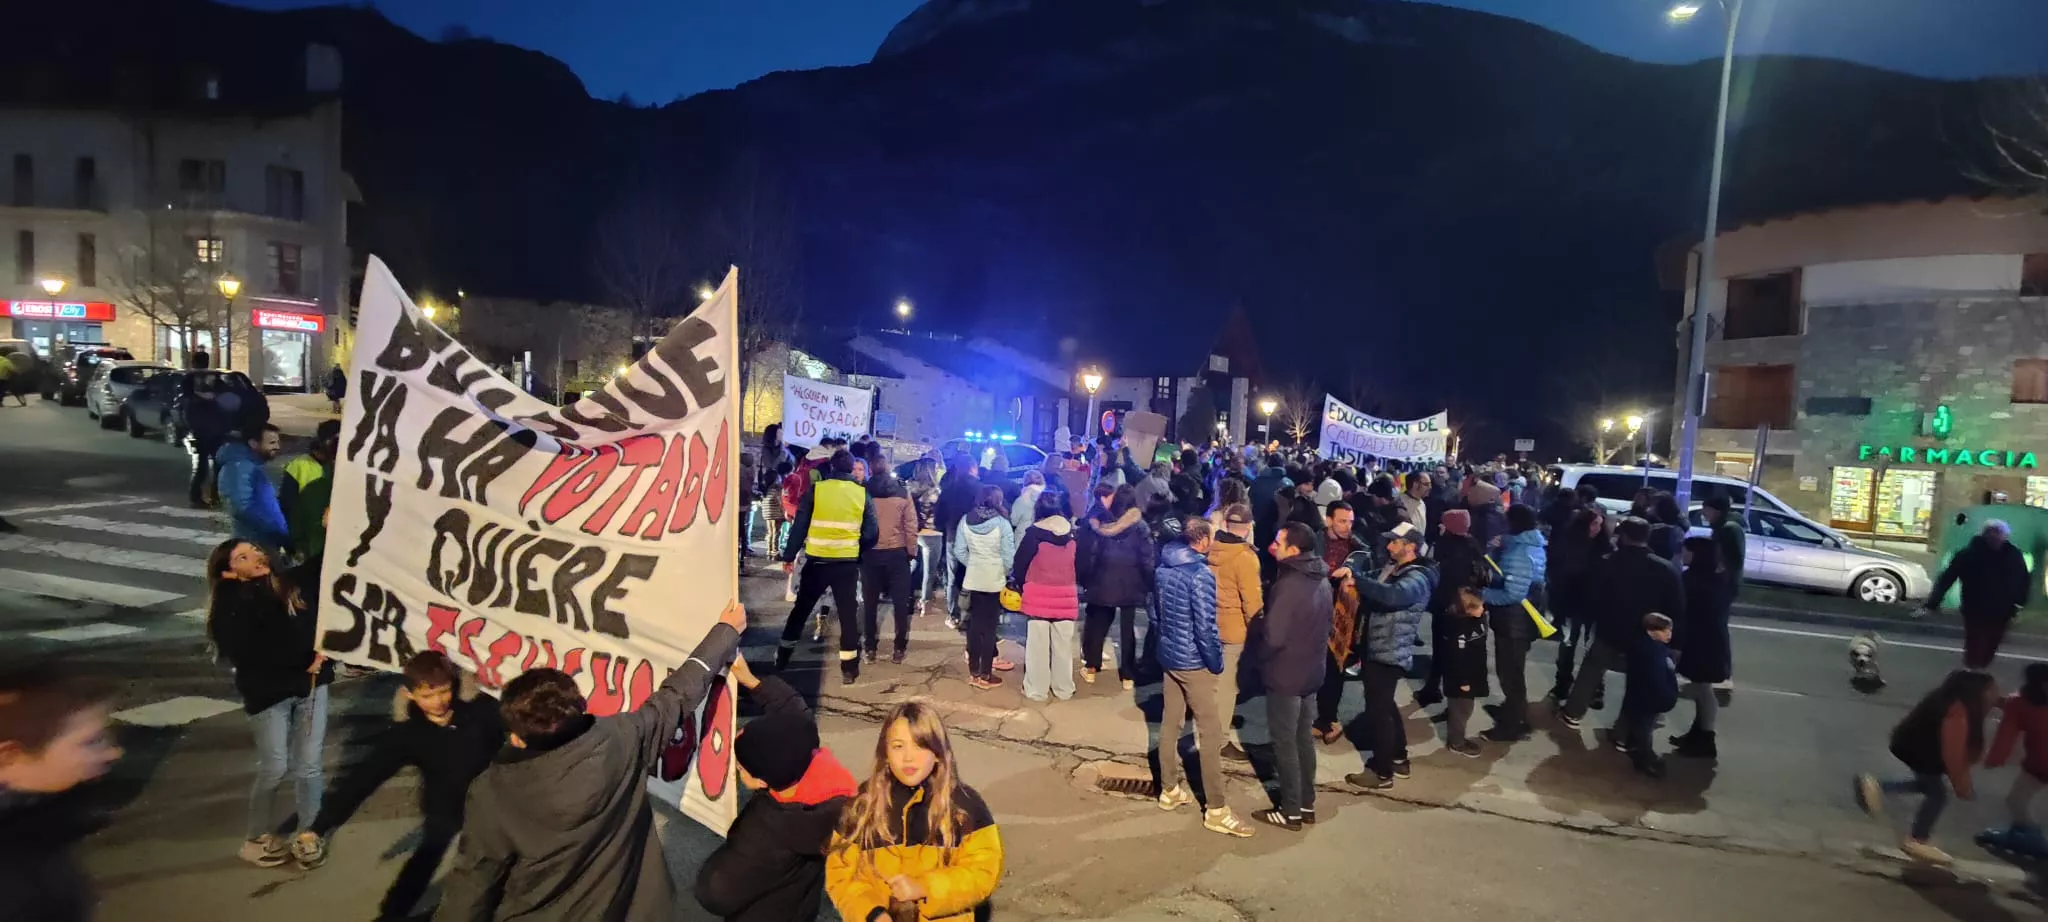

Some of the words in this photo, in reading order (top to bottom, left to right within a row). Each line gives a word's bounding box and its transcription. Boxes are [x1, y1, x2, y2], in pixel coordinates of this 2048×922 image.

[834, 394, 846, 409] HA
[795, 419, 817, 438] LOS
[1328, 402, 1409, 435] EDUCACIÓN
[1418, 417, 1437, 432] DE
[1326, 423, 1384, 453] CALIDAD
[1389, 437, 1409, 452] NO
[347, 371, 407, 474] YA
[416, 404, 538, 503] HA
[519, 418, 729, 541] VOTADO
[1859, 445, 2038, 468] FARMACIA
[345, 474, 394, 567] Y
[426, 507, 659, 640] QUIERE
[322, 573, 418, 668] SER
[425, 602, 733, 801] ESCHADO
